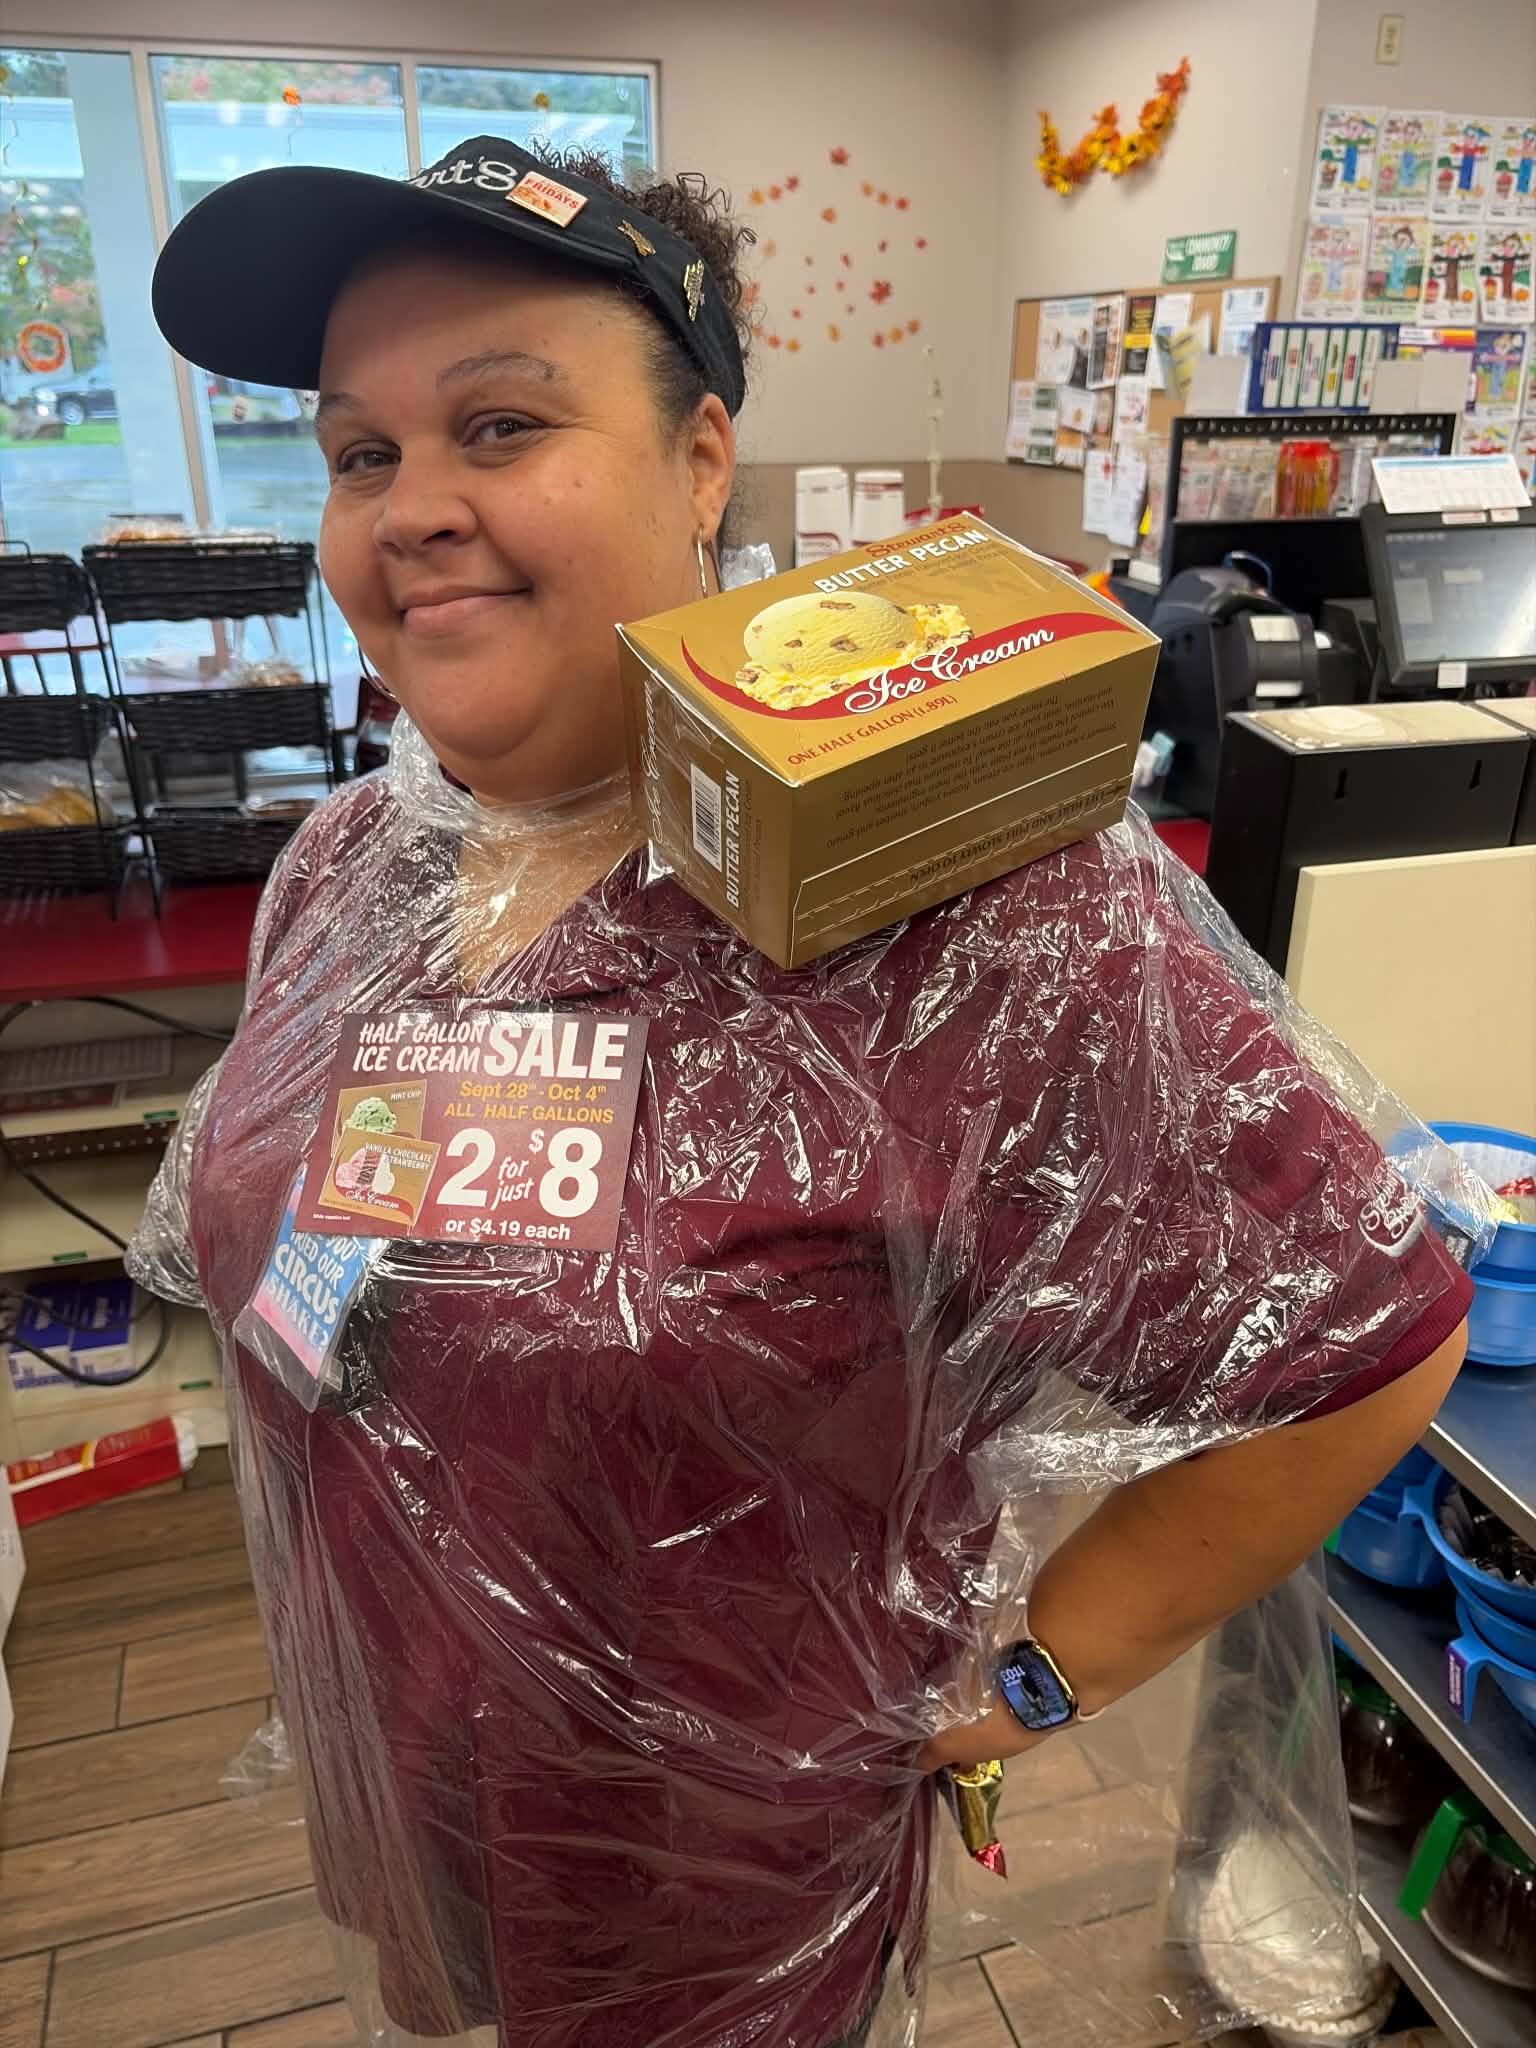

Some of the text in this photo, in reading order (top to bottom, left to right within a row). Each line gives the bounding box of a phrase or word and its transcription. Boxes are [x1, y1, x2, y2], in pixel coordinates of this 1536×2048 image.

[526, 178, 577, 209] FRIDAYS
[813, 554, 912, 593] BUTTER
[908, 529, 989, 562] PECAN
[844, 628, 1054, 713] Ice Cream
[788, 748, 817, 767] ONE
[818, 731, 856, 756] HALF
[856, 711, 914, 739] GALLON
[725, 769, 740, 908] BUTTER PECAN
[359, 1022, 485, 1045] HALF GALLON
[483, 1022, 629, 1080] SALE
[353, 1046, 481, 1074] ICE CREAM
[459, 1081, 502, 1101] Sept
[548, 1083, 582, 1101] Oct
[444, 1103, 615, 1124] ALL HALF GALLONS
[436, 1128, 496, 1207] 2
[498, 1155, 529, 1180] for
[490, 1177, 535, 1211] just
[445, 1217, 571, 1240] or $4.19 each
[274, 1243, 339, 1325] CIRCUS
[317, 1253, 345, 1290] OUR
